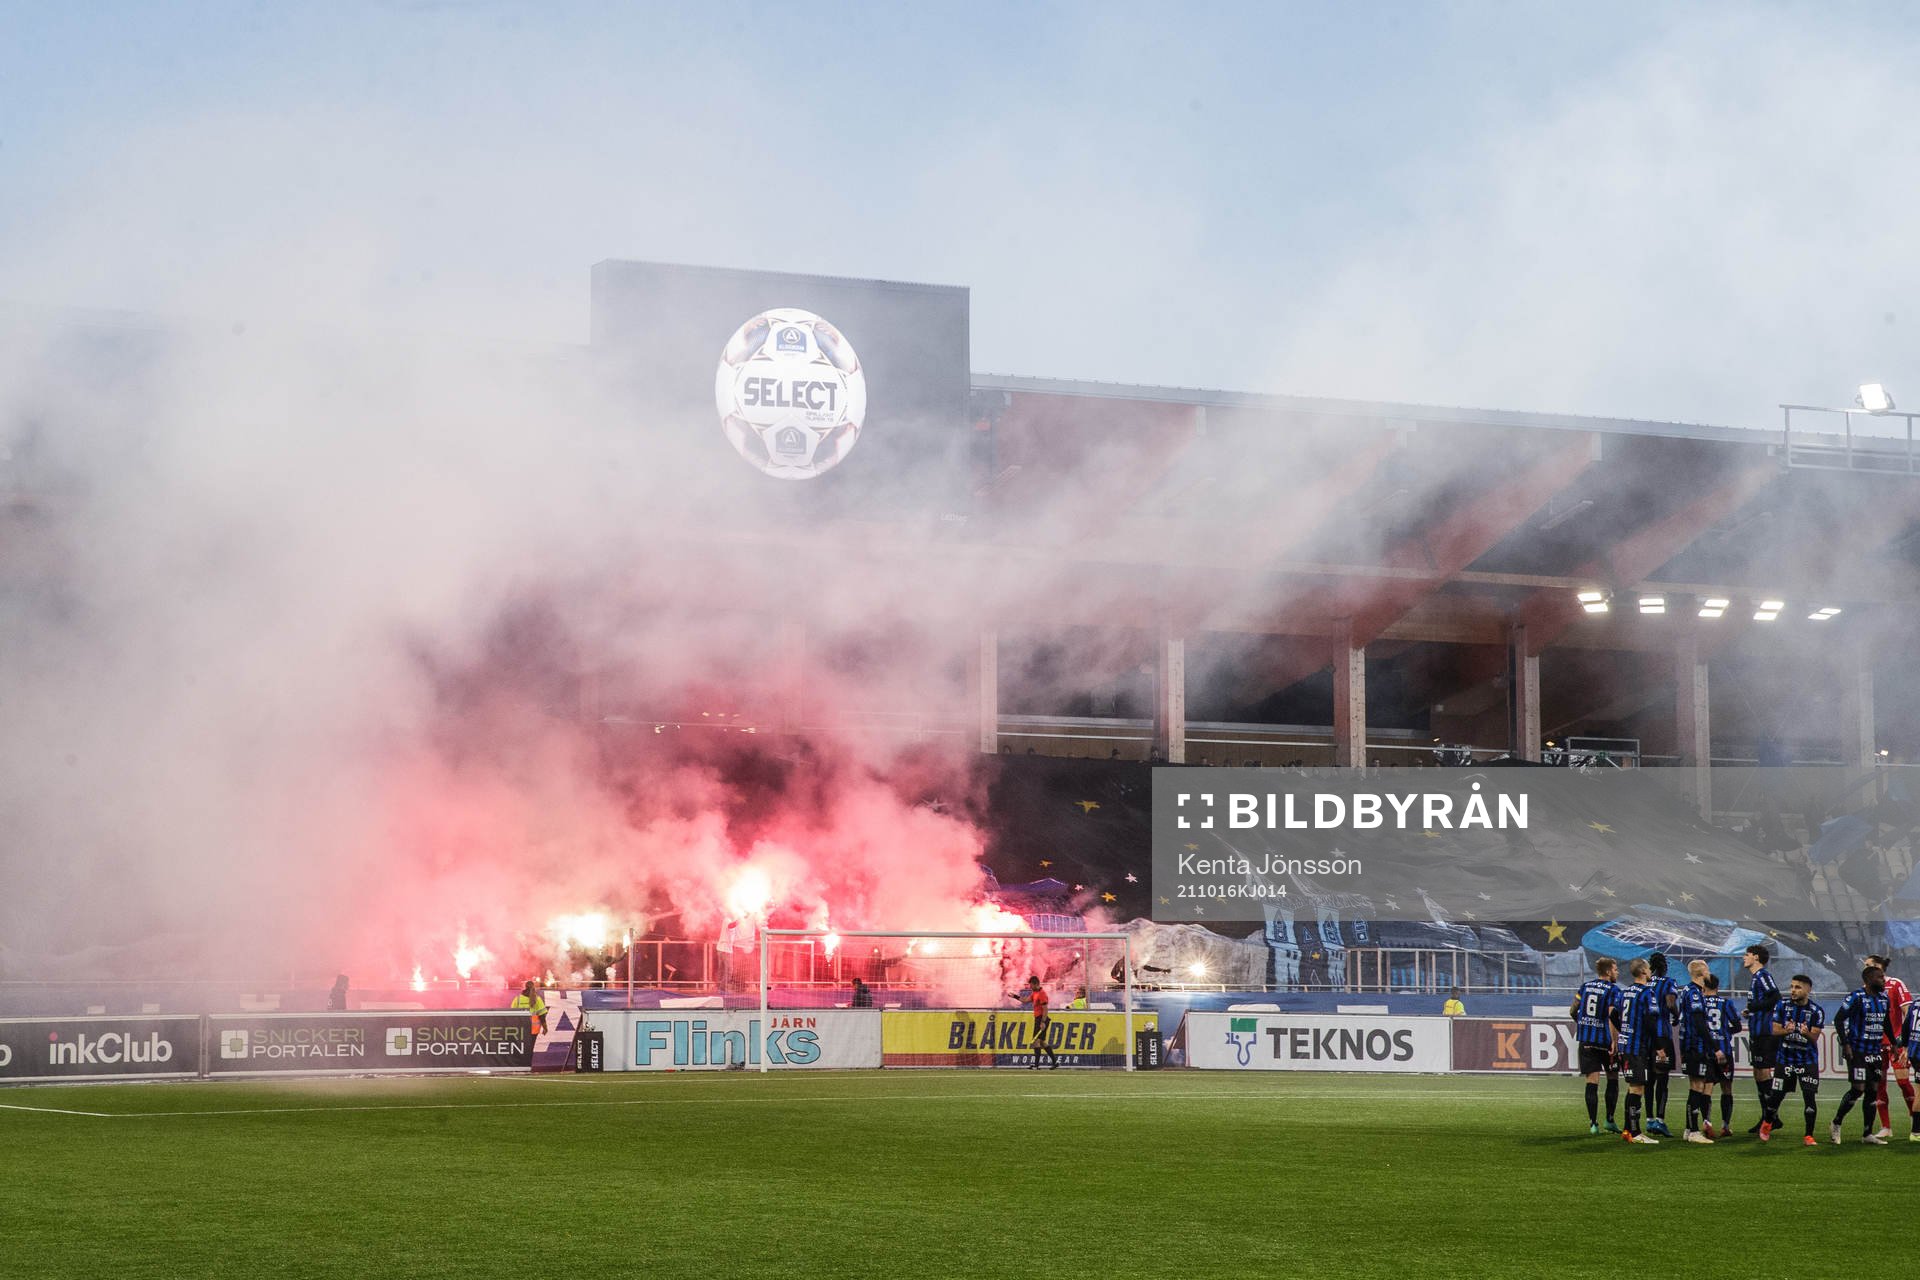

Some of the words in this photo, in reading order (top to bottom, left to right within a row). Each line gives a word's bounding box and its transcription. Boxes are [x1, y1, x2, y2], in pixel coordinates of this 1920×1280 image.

[744, 376, 838, 412] SELECT
[1586, 994, 1598, 1017] 6
[1622, 999, 1631, 1022] 2
[771, 1017, 816, 1029] JÄRN
[1705, 1008, 1721, 1031] 3
[253, 1027, 365, 1043] SNICKERI
[416, 1026, 525, 1042] SNICKERI
[636, 1020, 822, 1066] Flinks
[948, 1014, 1097, 1050] BLÅKLDER
[49, 1031, 173, 1065] inkClub
[253, 1042, 365, 1058] PORTALEN
[416, 1041, 525, 1056] PORTALEN
[590, 1040, 599, 1069] SELECT
[1149, 1039, 1157, 1065] SELECT
[1266, 1027, 1414, 1062] TEKNOS
